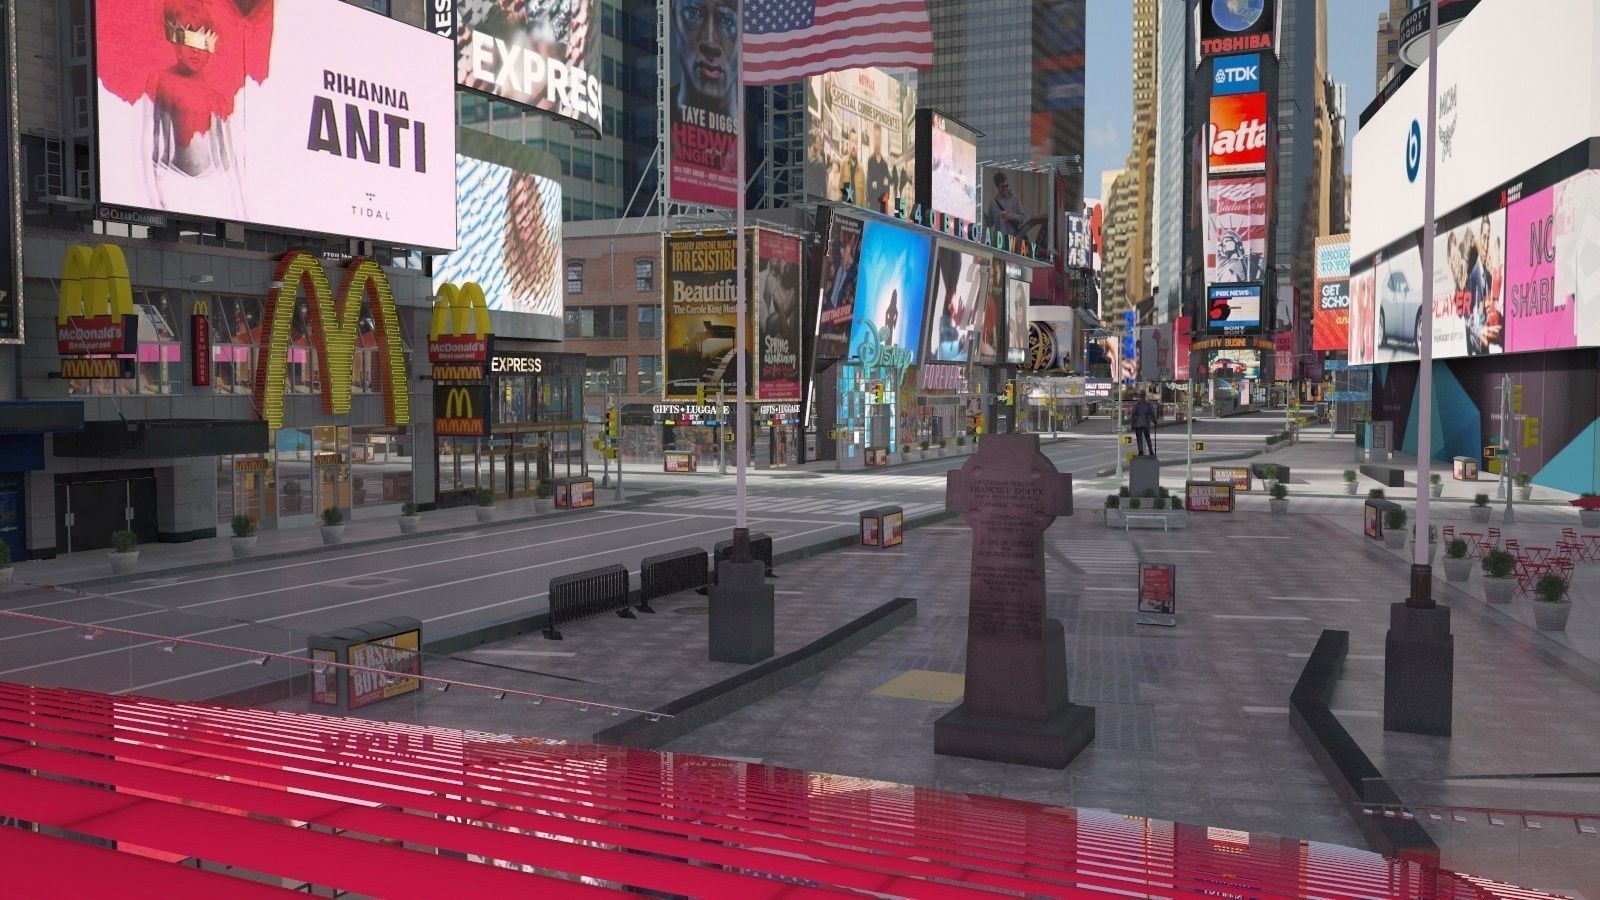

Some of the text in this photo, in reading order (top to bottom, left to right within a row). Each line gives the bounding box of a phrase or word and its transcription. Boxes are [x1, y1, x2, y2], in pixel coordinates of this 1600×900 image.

[1401, 6, 1428, 32] RIOTT
[1202, 33, 1271, 53] TOSHIBA
[1401, 21, 1422, 44] QUIS
[472, 29, 602, 127] EXPRES
[1225, 65, 1258, 83] TDK
[323, 69, 410, 111] RIHANNA
[833, 89, 857, 112] SPECIAL
[681, 104, 739, 135] TAYE DIGGS
[307, 94, 427, 174] ANTI
[351, 205, 391, 221] TIDAL
[943, 214, 1037, 260] BROADWAY
[672, 249, 747, 272] IRRESISTIBL
[1229, 289, 1250, 297] NEWS
[1322, 284, 1341, 297] GET
[1511, 276, 1566, 318] SHARI
[58, 326, 122, 341] McDonald's
[68, 341, 111, 350] Restaurant
[430, 342, 485, 352] McDonald's
[491, 357, 542, 372] EXPRESS
[923, 364, 960, 390] FOREVER
[653, 405, 730, 415] GIFTS LUGGAE
[760, 405, 800, 415] GIFTS LUGGAGE
[353, 669, 387, 697] BOYS
